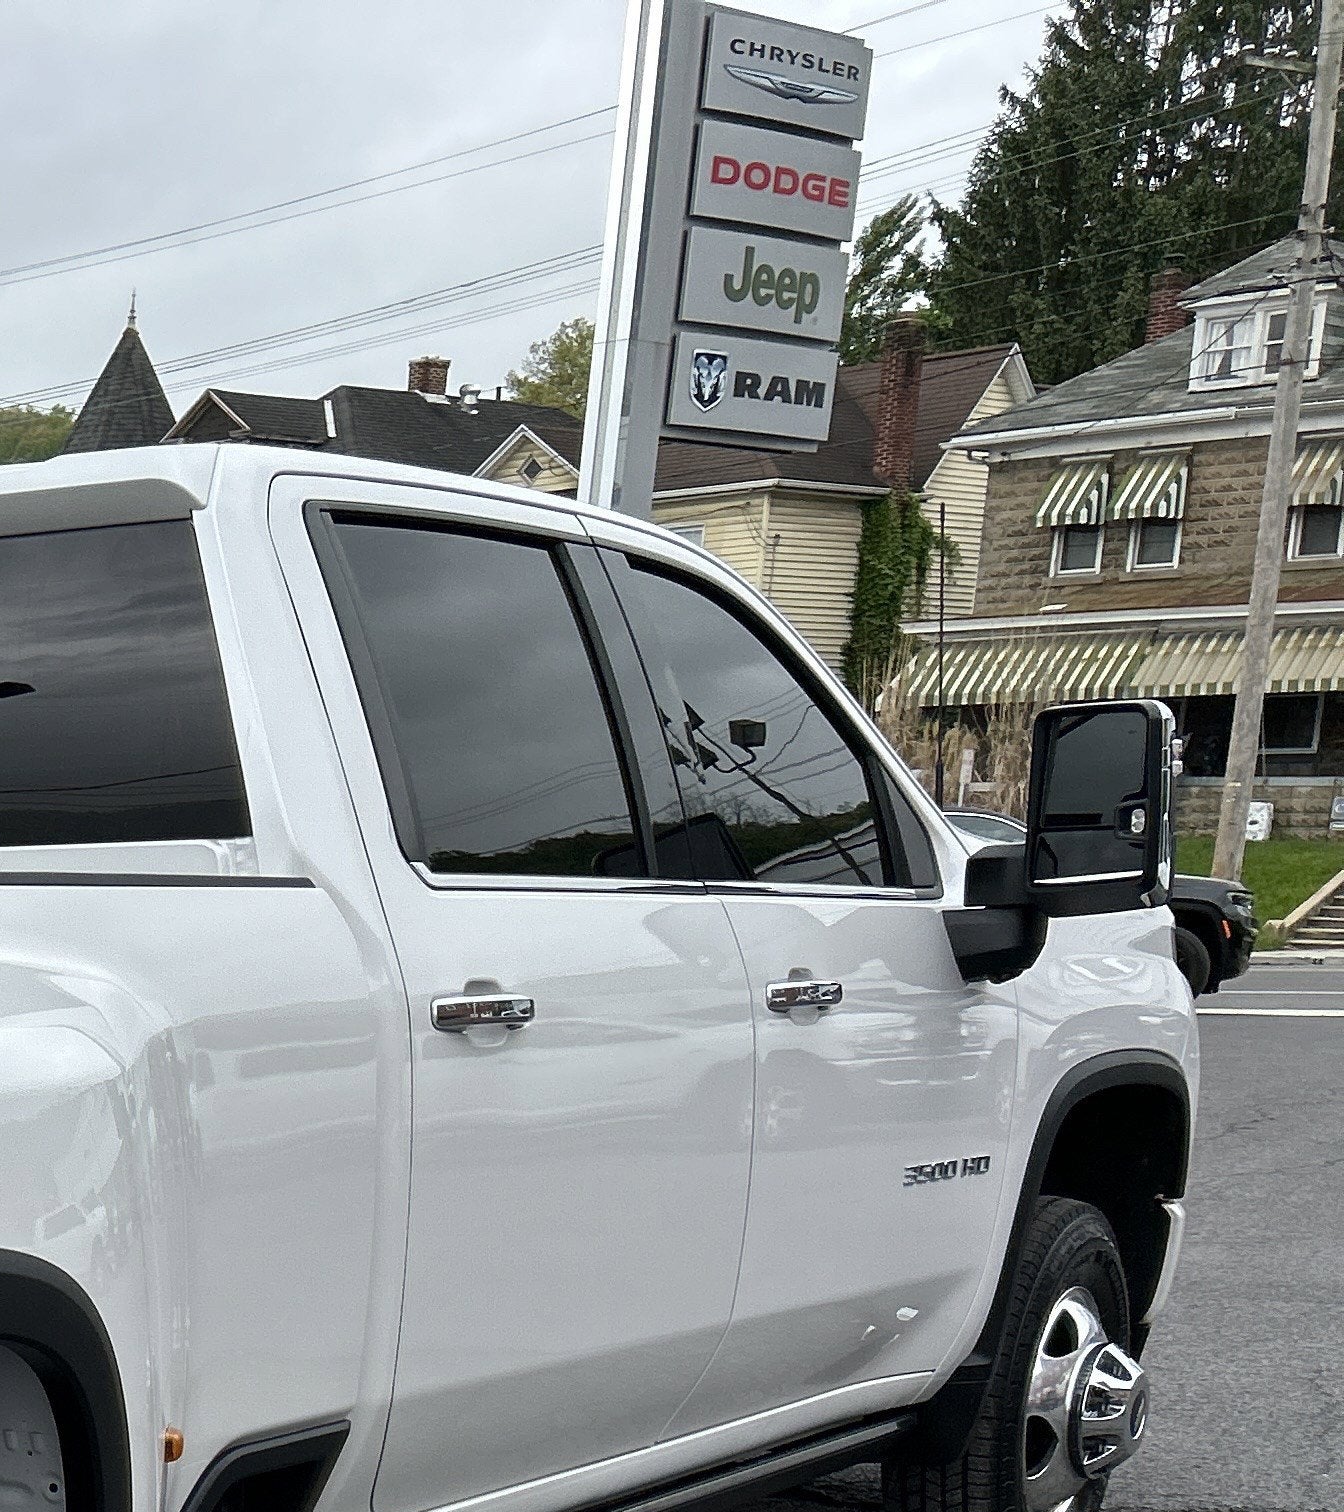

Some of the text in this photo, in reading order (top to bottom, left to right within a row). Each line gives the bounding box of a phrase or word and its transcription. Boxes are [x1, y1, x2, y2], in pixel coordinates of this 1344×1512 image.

[729, 38, 860, 82] CHRYSLER
[711, 155, 851, 209] DODGE
[723, 246, 821, 324] Jeep
[733, 371, 827, 409] RAM
[902, 1155, 991, 1187] 3500 HD
